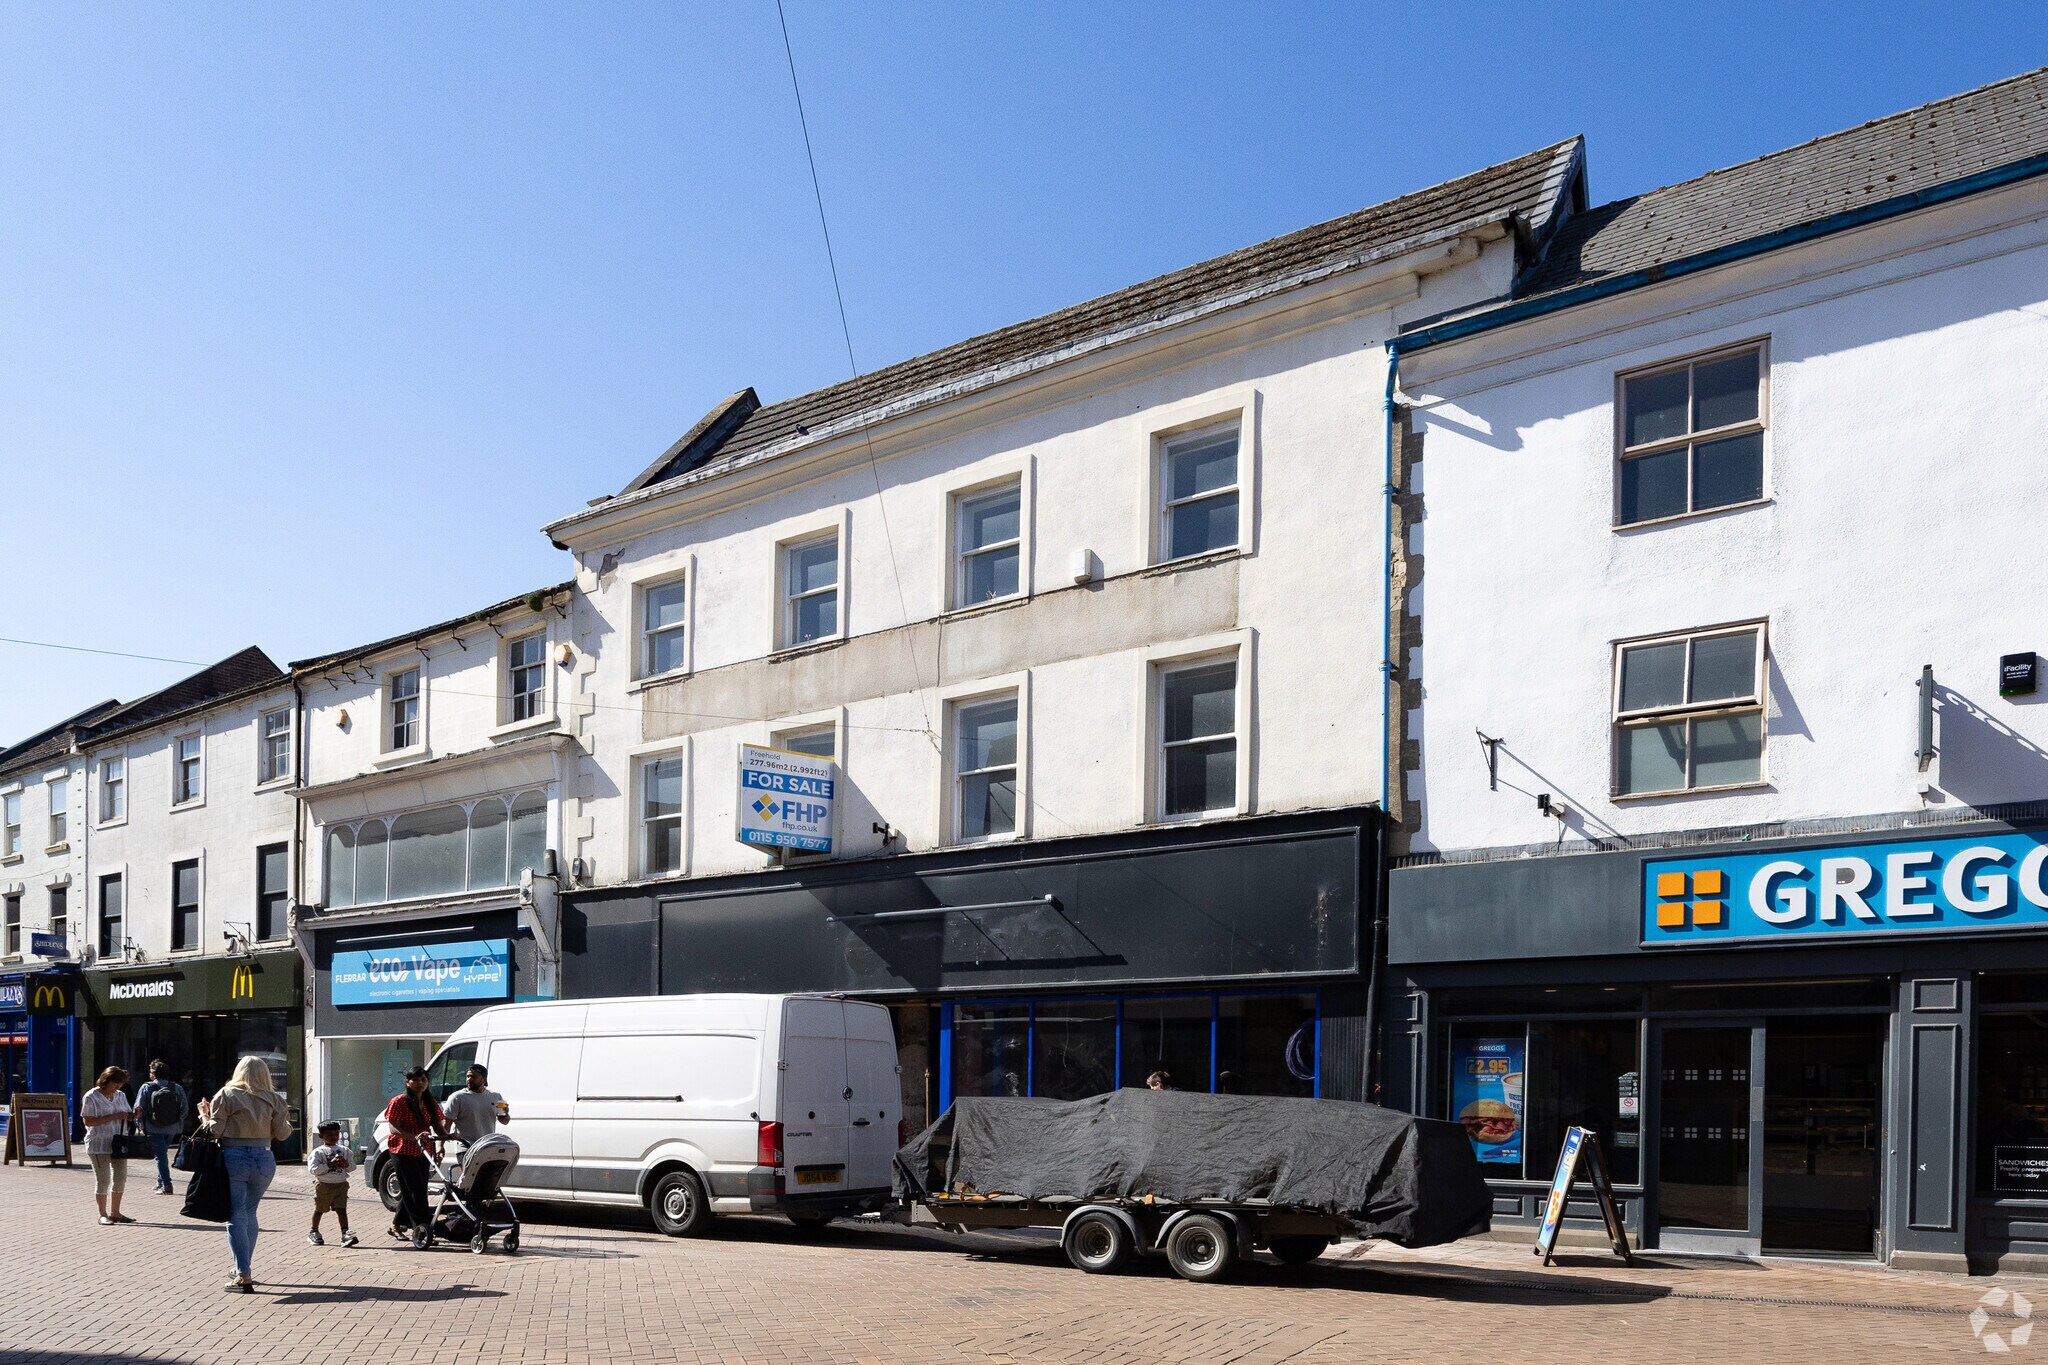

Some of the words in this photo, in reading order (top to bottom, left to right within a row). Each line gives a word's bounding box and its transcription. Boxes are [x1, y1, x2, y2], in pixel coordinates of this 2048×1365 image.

[750, 750, 780, 761] Freehold
[749, 758, 788, 771] 277.96m2
[748, 772, 784, 790] FOR
[789, 778, 831, 796] SALE
[782, 800, 828, 824] FHP
[782, 821, 818, 832] fhp.co.uk
[749, 830, 773, 842] 0115
[776, 834, 798, 846] 950
[800, 837, 829, 850] 7577
[369, 957, 402, 984] eco
[411, 954, 461, 986] Vape
[463, 973, 500, 984] HYPPE
[110, 980, 174, 1000] McDonald's
[418, 986, 434, 995] vaping
[1468, 1059, 1508, 1074] £2.95
